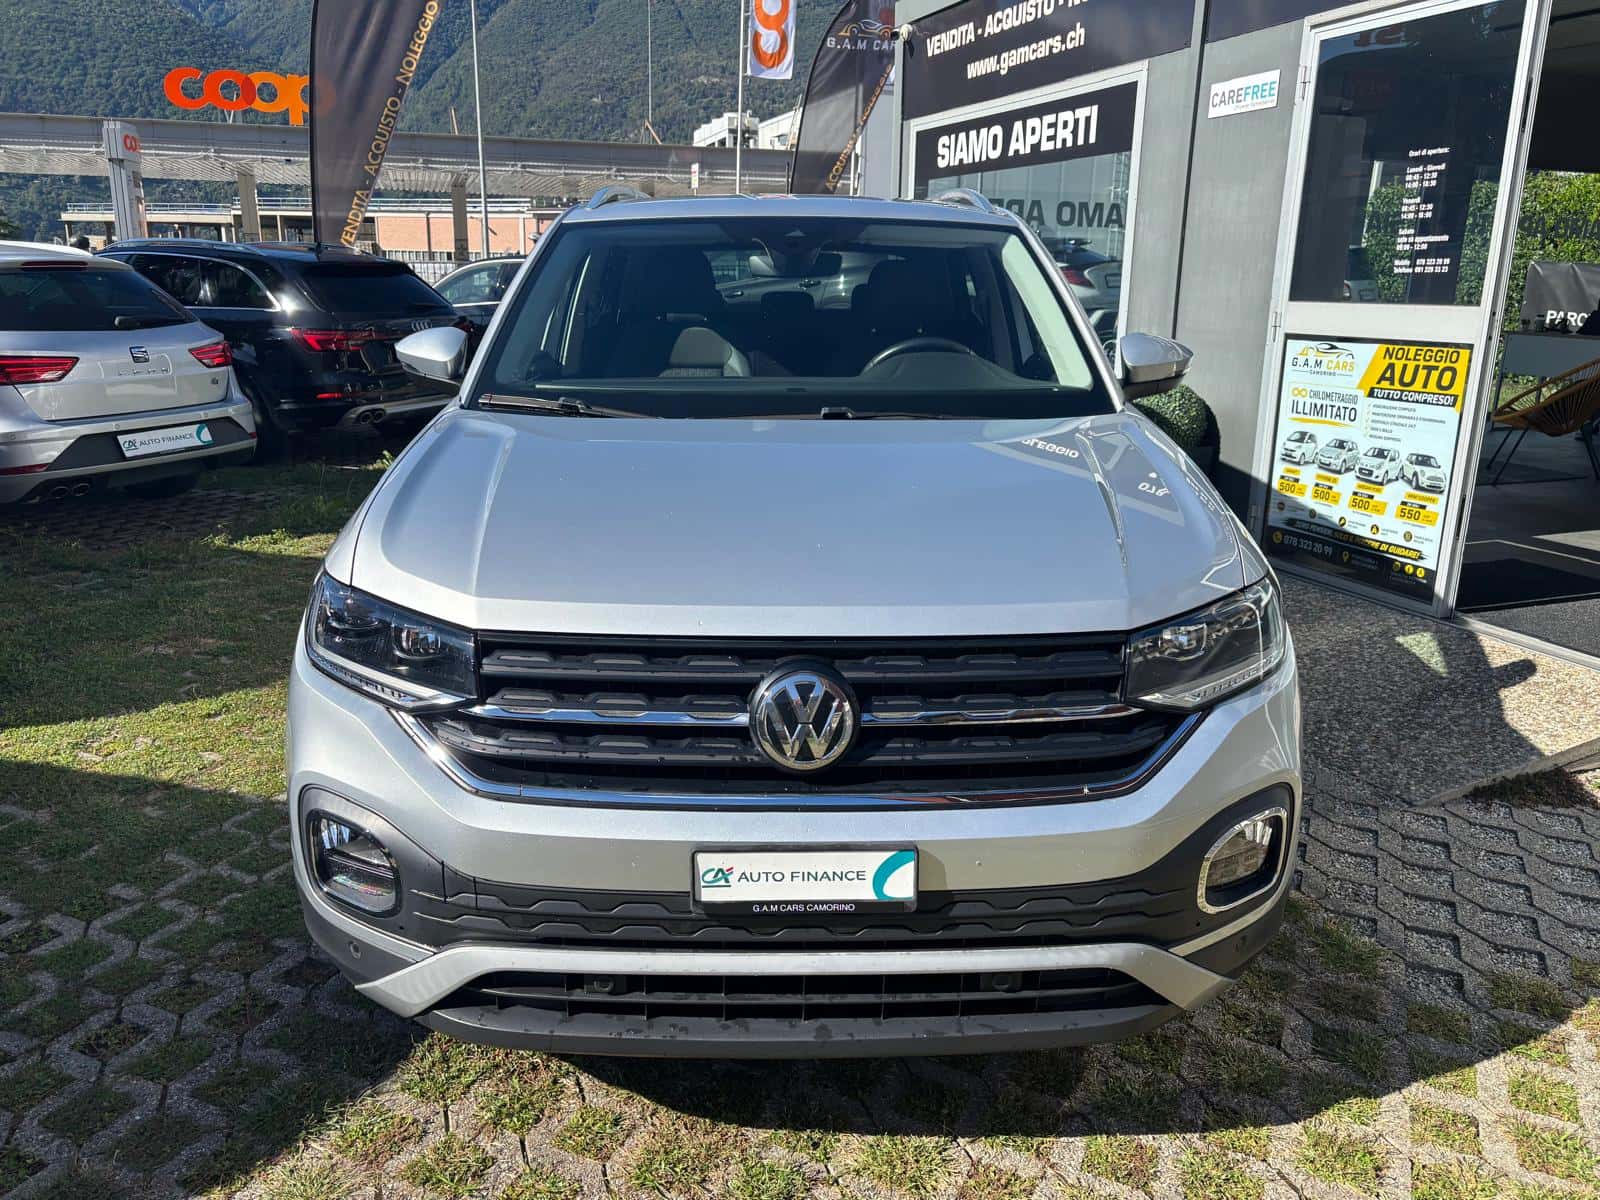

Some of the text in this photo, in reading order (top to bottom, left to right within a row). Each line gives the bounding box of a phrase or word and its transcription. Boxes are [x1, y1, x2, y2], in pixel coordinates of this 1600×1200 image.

[926, 0, 1055, 57] VENDITA ACQUISTO
[967, 22, 1086, 79] www.gamcars.ch
[1211, 80, 1277, 108] CAREFREE
[341, 0, 439, 247] VENDITA ACQUISTO NOLEGGIO
[937, 104, 1099, 168] SIAMO APERTI
[1383, 347, 1460, 364] NOLEGGIO
[1291, 357, 1355, 372] G.A.M CARS
[1376, 362, 1458, 391] AUTO
[1308, 389, 1359, 405] CHILOMETRAGGIO
[1373, 388, 1455, 405] TUTTO COMPRESO!
[1291, 399, 1358, 422] ILLIMITATO
[139, 438, 161, 447] AUTO
[1279, 481, 1296, 494] 500
[1312, 488, 1330, 502] 500
[1351, 497, 1370, 511] 500
[1399, 508, 1421, 521] 550
[738, 871, 785, 883] AUTO
[790, 870, 867, 882] FINANCE
[752, 903, 856, 913] G.A.M CARS CAMORINO
